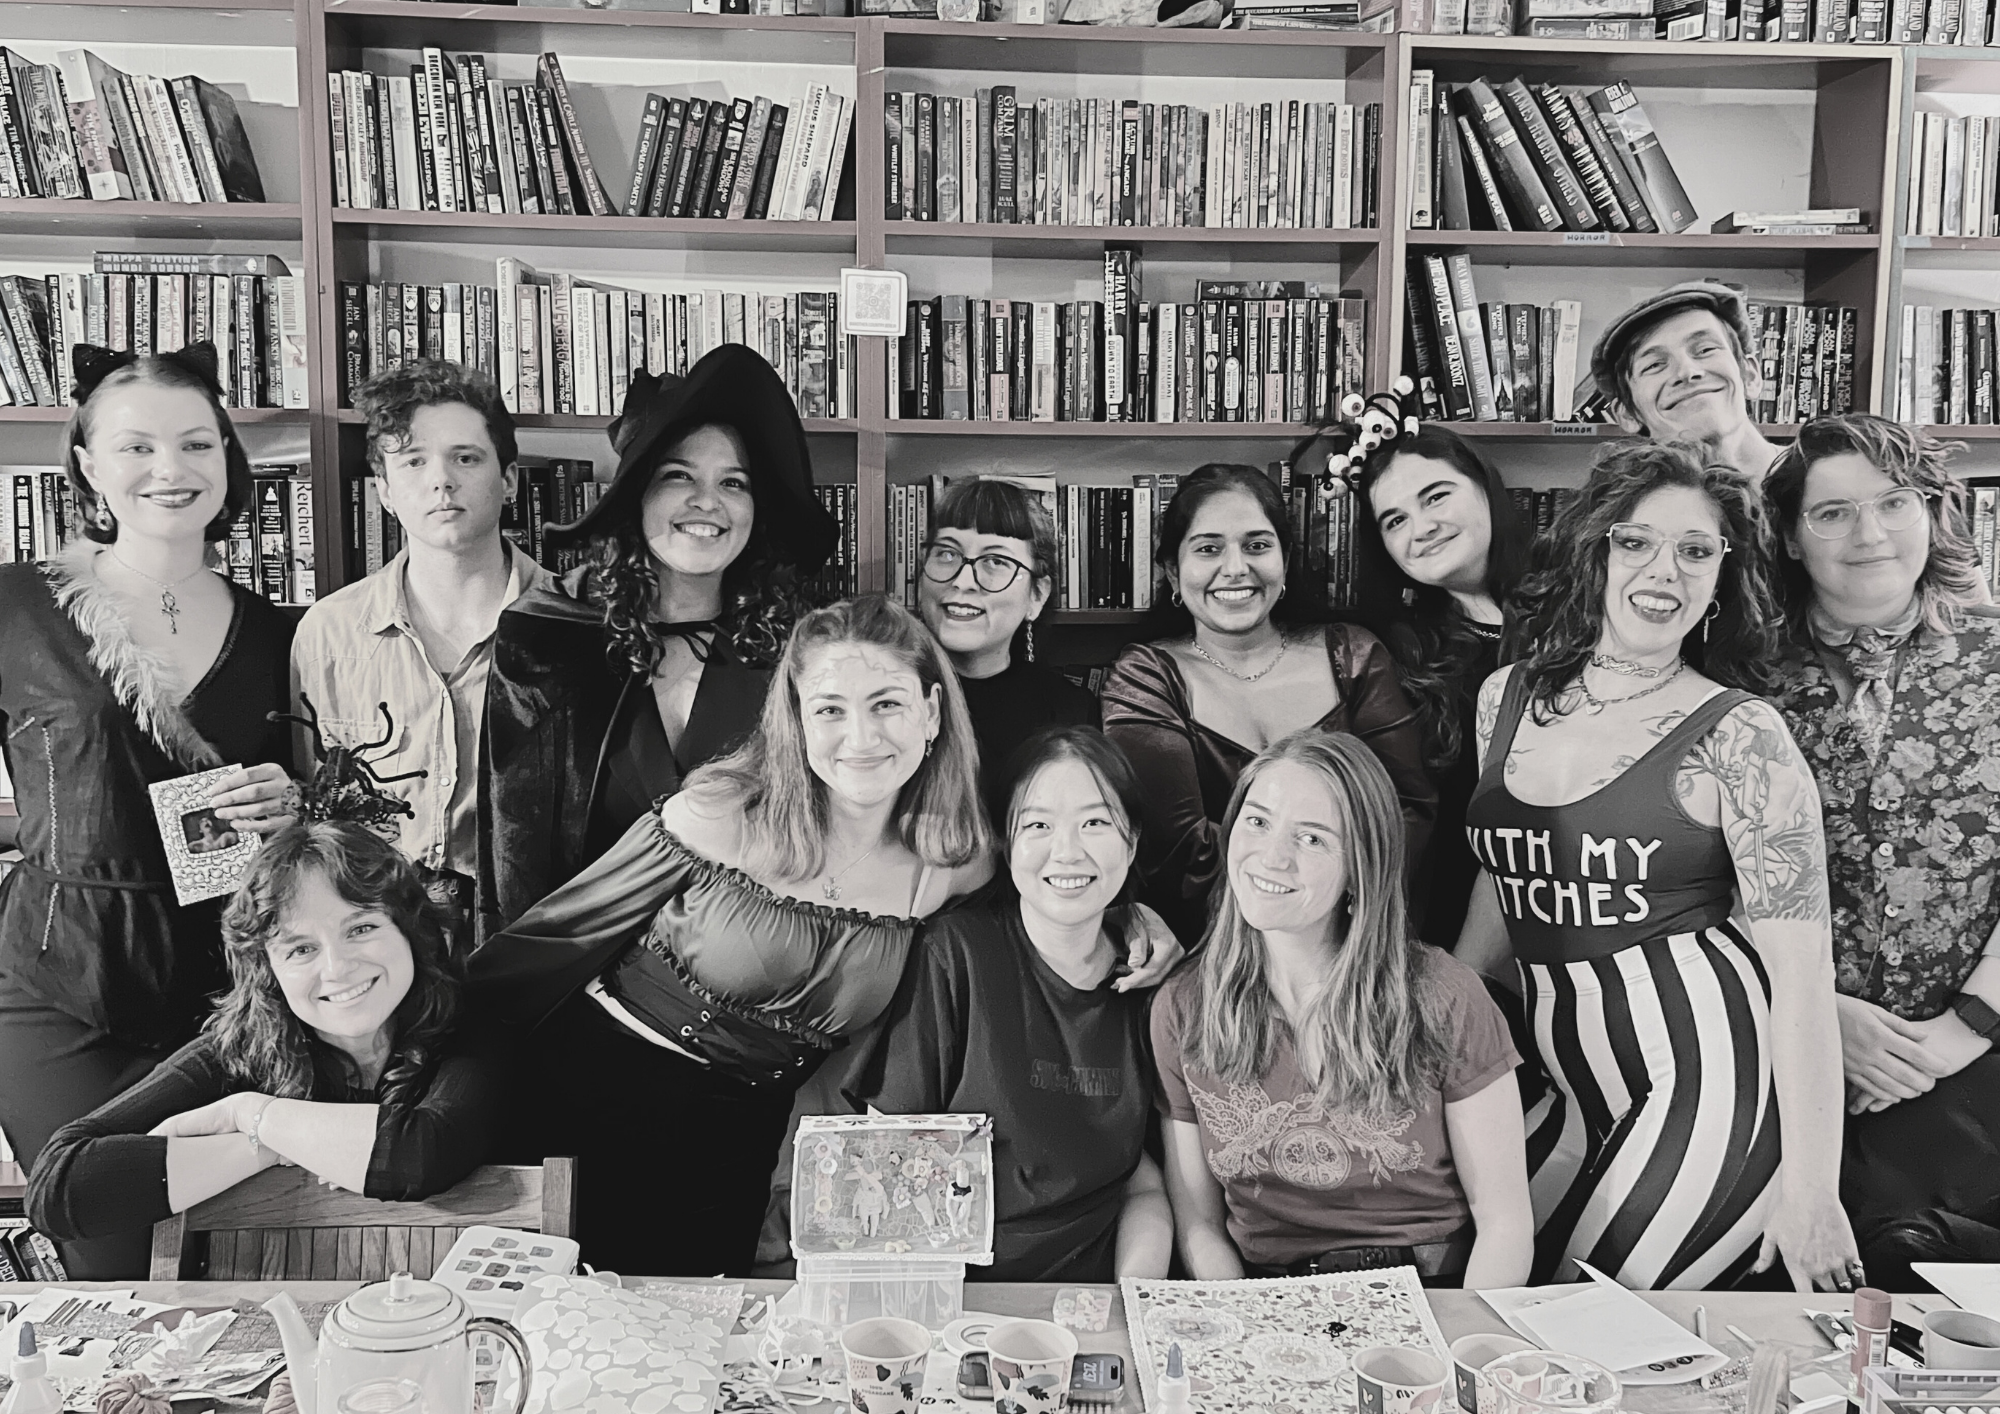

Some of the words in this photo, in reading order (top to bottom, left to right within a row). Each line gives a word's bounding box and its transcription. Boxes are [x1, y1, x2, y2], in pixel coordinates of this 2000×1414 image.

[429, 55, 441, 92] DRACONIAN
[433, 95, 443, 109] NEW
[807, 86, 816, 105] LIFE
[812, 89, 823, 121] LUCIUS
[1542, 86, 1575, 130] JAMES
[1, 97, 11, 124] PALACE
[435, 112, 445, 128] YORK
[1004, 96, 1014, 137] GRIM
[160, 102, 177, 139] STARFIRE
[173, 144, 183, 160] PAUL
[355, 77, 363, 103] ROBERT
[359, 142, 367, 182] MINDSWAP
[799, 108, 811, 144] DURING
[1586, 123, 1606, 154] HORROR
[1596, 133, 1606, 142] BEST
[8, 126, 17, 142] TIM
[13, 144, 27, 179] POWERS
[802, 124, 815, 167] SHEPARD
[1508, 89, 1534, 122] JAMES
[1528, 122, 1558, 164] HERBERT
[1554, 167, 1578, 206] OTHERS
[550, 148, 568, 195] FRONTERA
[717, 159, 729, 191] SHADOWS
[724, 166, 734, 187] ROADS
[789, 148, 803, 191] WARTIME
[1572, 144, 1616, 209] HERBERT
[1611, 173, 1619, 184] YEAR
[674, 184, 686, 204] FLIGHT
[720, 187, 728, 202] AND
[1567, 234, 1605, 242] HORROR
[151, 256, 199, 264] JUSTINA
[151, 264, 199, 273] ROBSON
[1430, 258, 1446, 277] THE
[1456, 258, 1467, 277] DEAN
[13, 292, 22, 304] THE
[1115, 276, 1126, 315] HARRY
[1433, 278, 1450, 296] BAD
[1460, 279, 1473, 308] KOONTZ
[17, 306, 33, 340] GREATEST
[269, 295, 278, 326] ROBERT
[1436, 298, 1453, 326] PLACE
[1271, 318, 1279, 336] HARRY
[1802, 318, 1810, 348] KOONTZ
[8, 308, 26, 345] ROBERT
[19, 347, 38, 384] RANKIN
[27, 340, 39, 361] SHOW
[270, 328, 279, 360] RANKIN
[1445, 335, 1459, 354] DEAN
[1469, 338, 1481, 359] SEIZE
[1449, 361, 1464, 387] KOONTZ
[1473, 361, 1484, 375] THE
[1800, 367, 1806, 376] OF
[38, 374, 52, 397] EARTH
[1474, 376, 1488, 398] NIGHT
[1798, 379, 1806, 411] TWILIGHT
[1555, 426, 1592, 434] HORROR
[297, 482, 313, 546] Reichert
[1581, 832, 1662, 880] MY
[1489, 872, 1649, 926] ITCHES
